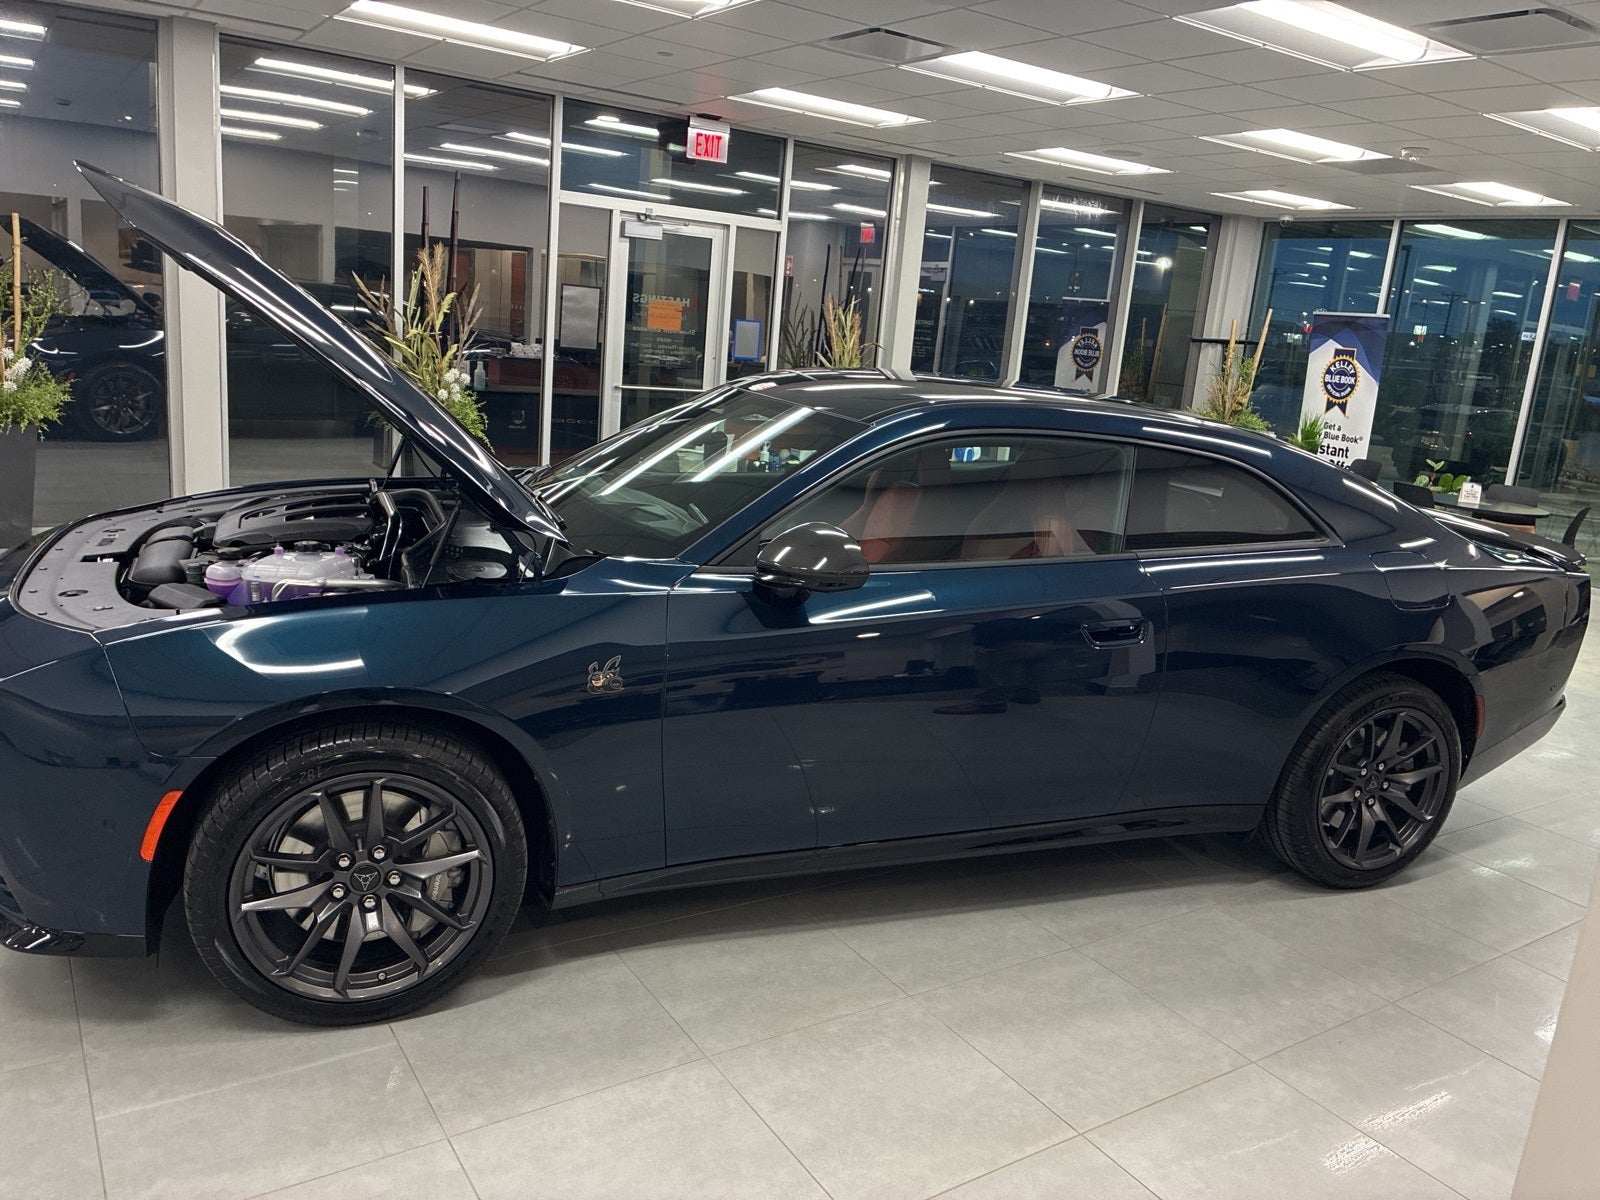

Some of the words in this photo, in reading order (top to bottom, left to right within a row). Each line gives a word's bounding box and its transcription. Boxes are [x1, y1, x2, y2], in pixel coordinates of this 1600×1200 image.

[695, 132, 722, 159] EXIT
[1330, 361, 1355, 374] KELLEY
[1324, 374, 1341, 384] BLUE
[1341, 375, 1356, 385] BOOK
[1323, 422, 1336, 431] Get
[1323, 431, 1340, 441] Blue
[1319, 443, 1350, 459] stant
